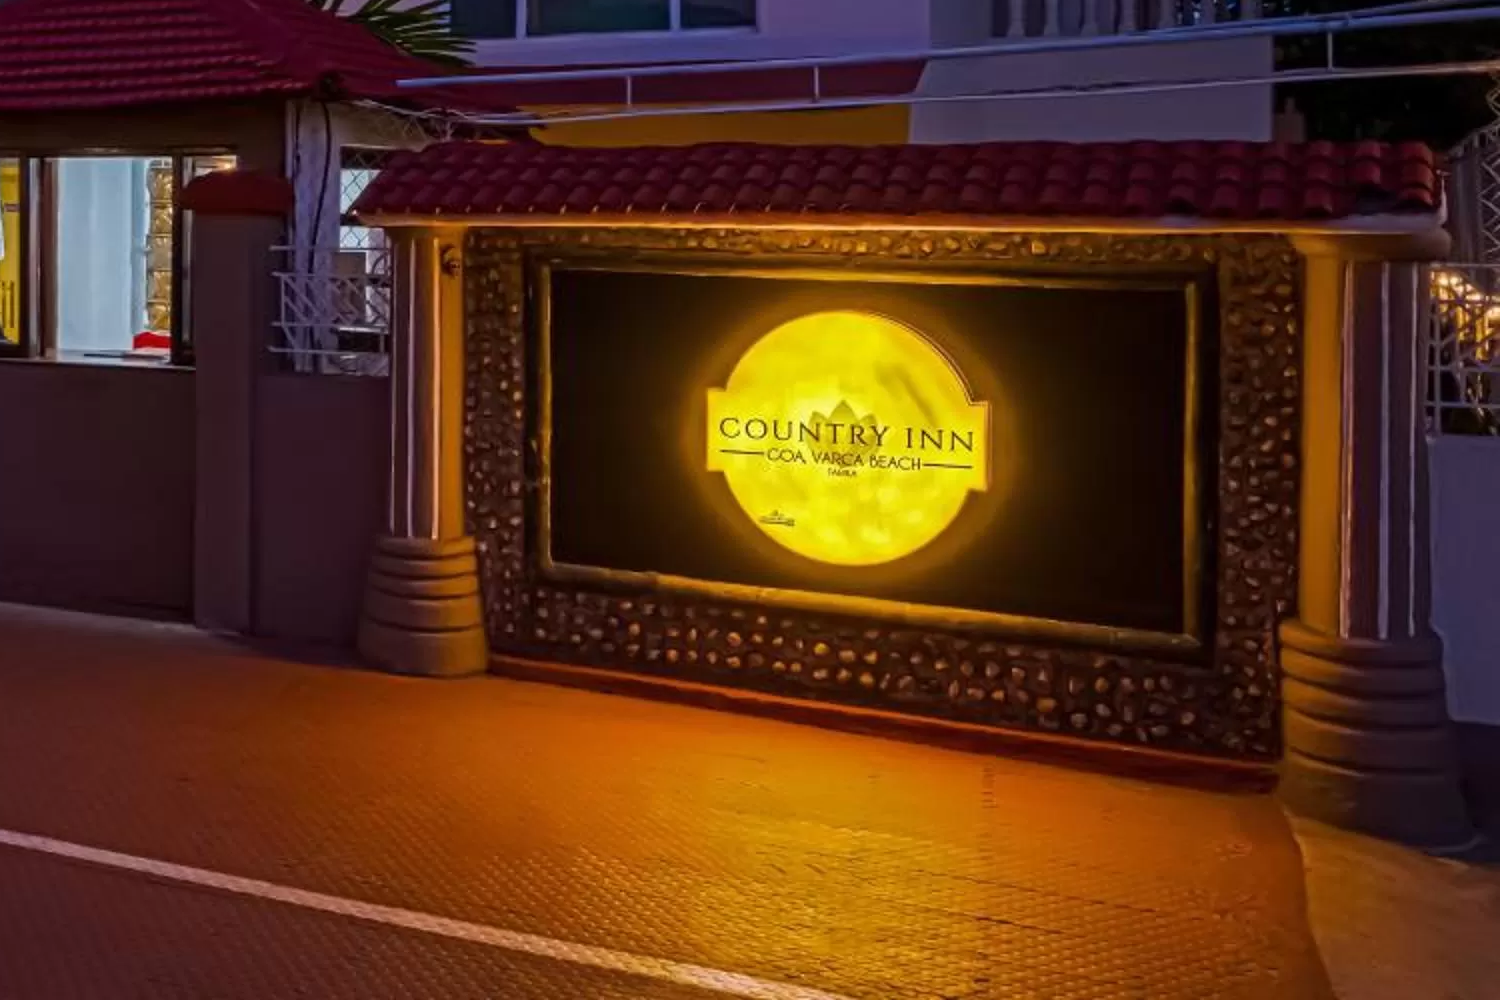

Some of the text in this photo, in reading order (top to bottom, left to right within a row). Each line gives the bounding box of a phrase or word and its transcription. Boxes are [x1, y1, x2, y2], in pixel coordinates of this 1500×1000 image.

[719, 417, 974, 452] COUNTRY INN
[869, 455, 921, 471] BEACH
